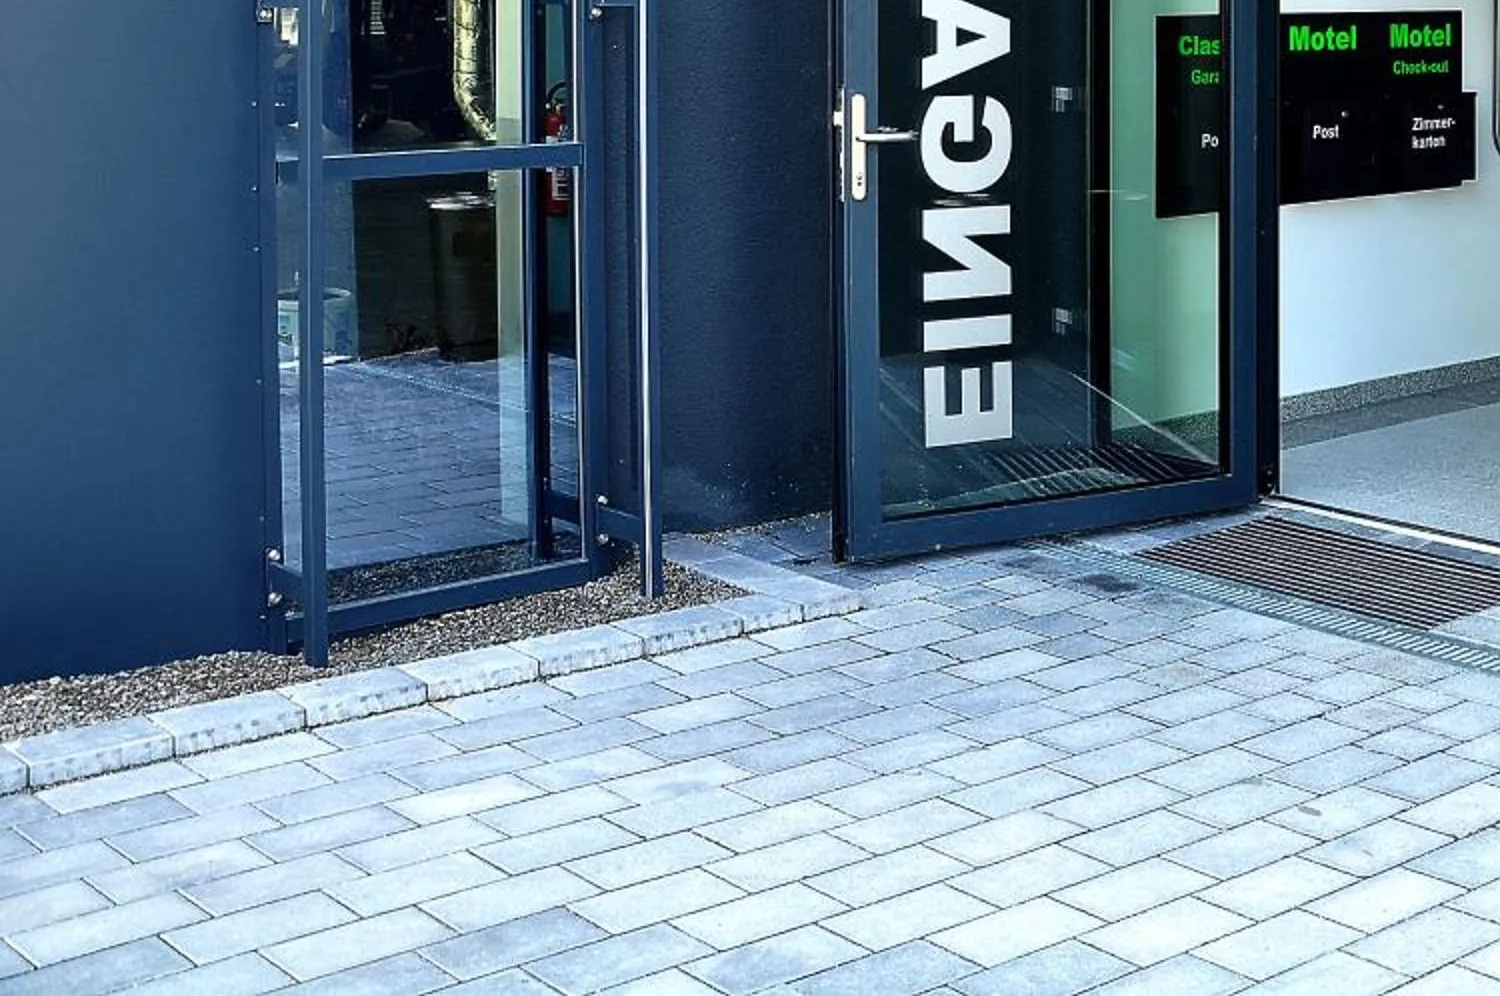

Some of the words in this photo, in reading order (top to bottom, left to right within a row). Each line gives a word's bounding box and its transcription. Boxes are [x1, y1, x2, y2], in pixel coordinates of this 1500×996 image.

[1289, 24, 1358, 51] Motel
[1389, 23, 1452, 48] Motel
[1392, 60, 1450, 75] Check-out
[1312, 124, 1340, 140] Post
[1411, 117, 1457, 132] Zimmer-
[1411, 135, 1446, 150] karten
